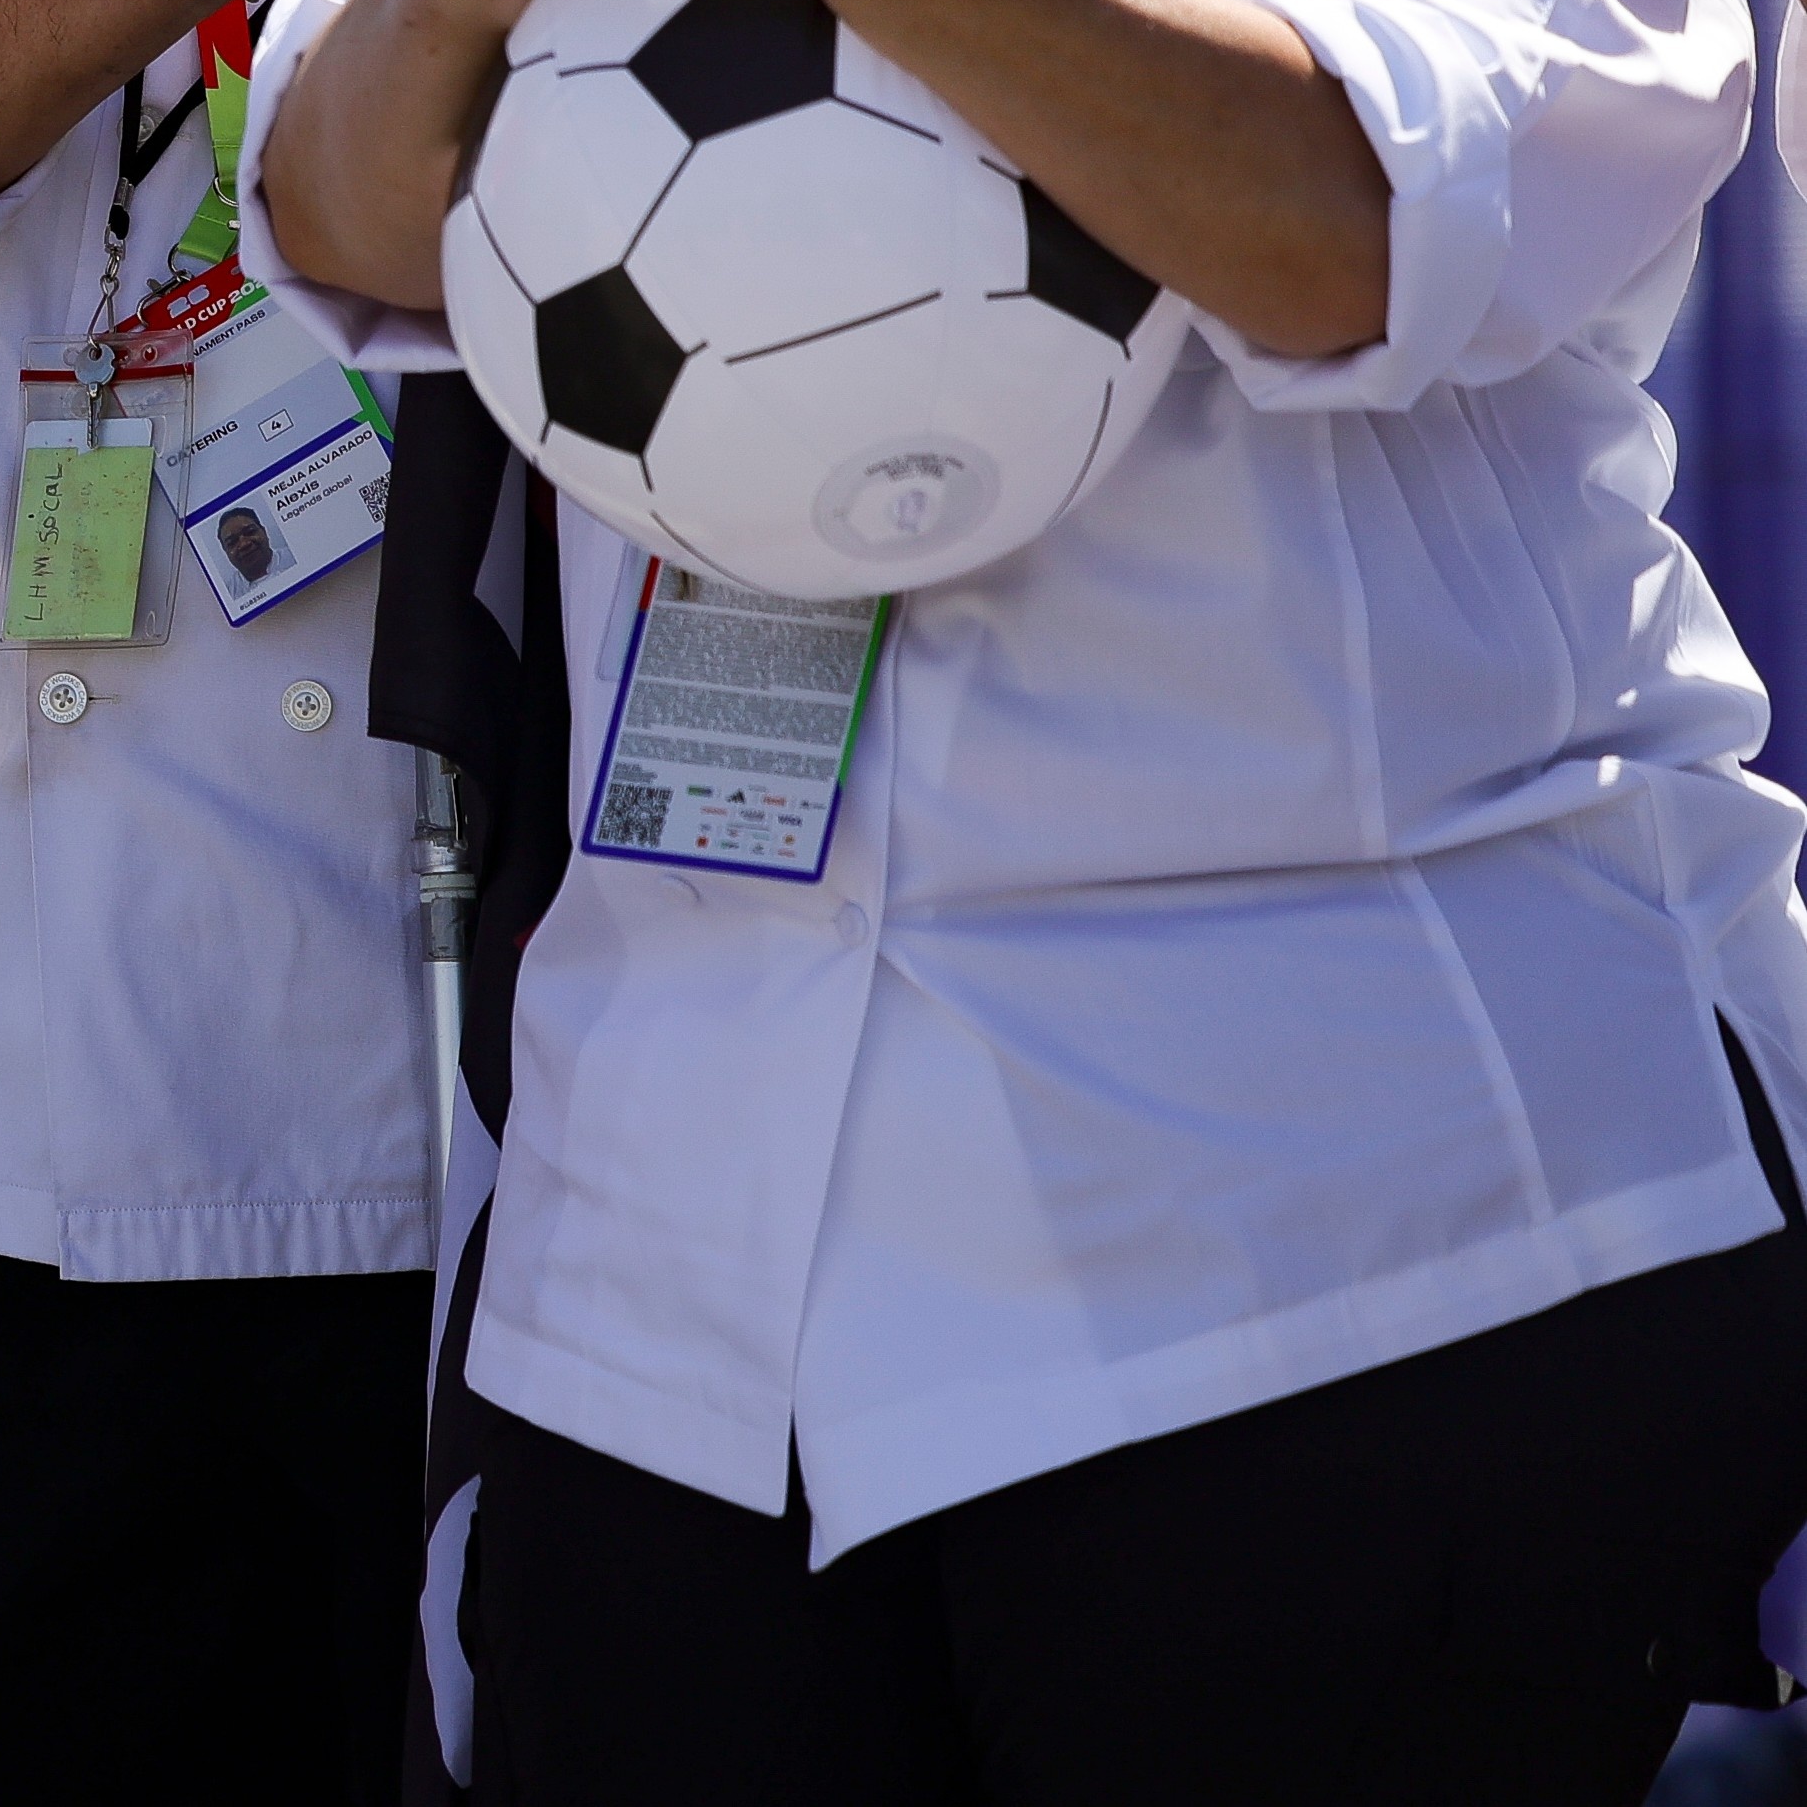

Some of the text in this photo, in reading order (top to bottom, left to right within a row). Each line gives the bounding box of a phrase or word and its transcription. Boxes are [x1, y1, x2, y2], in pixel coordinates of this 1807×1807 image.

[198, 298, 227, 321] CUP
[236, 309, 266, 332] PASS
[166, 420, 239, 468] CATERING
[271, 420, 281, 431] 4
[267, 429, 373, 498] MEJIA ALVARADO
[275, 480, 320, 511] Alexis
[280, 474, 353, 523] Legends Global
[41, 675, 85, 722] CHEF WORKS CHEF WORKS
